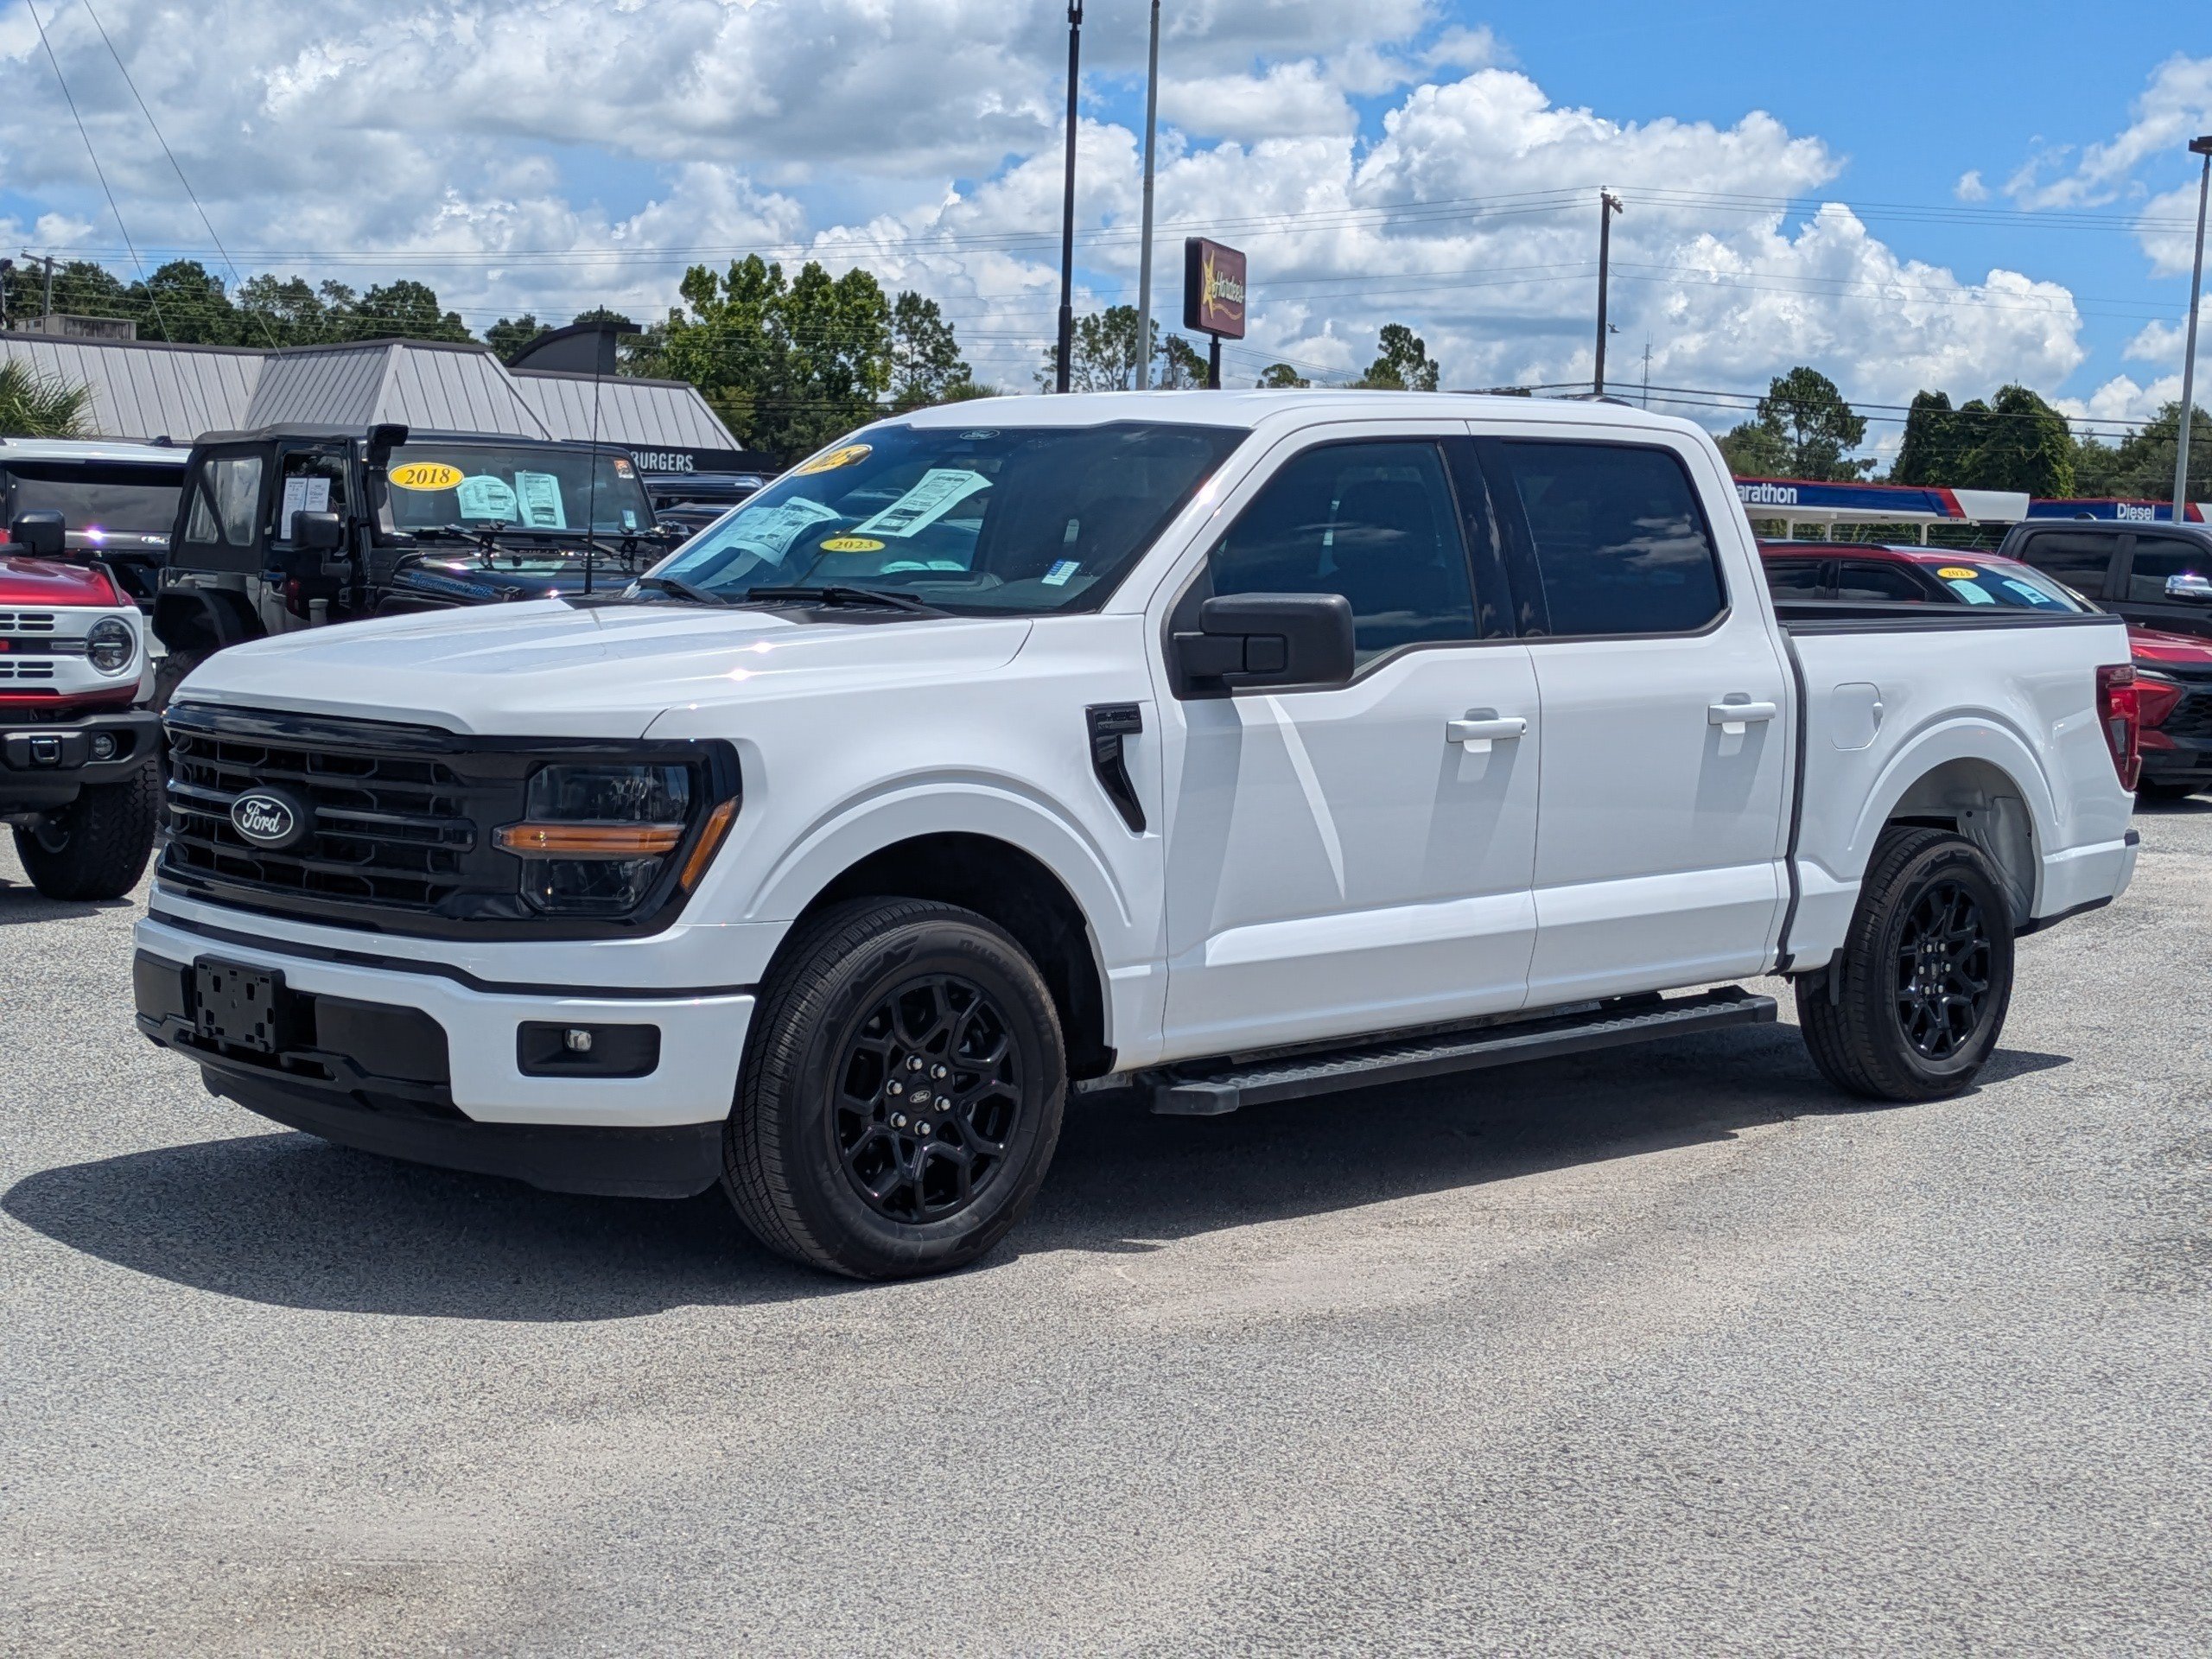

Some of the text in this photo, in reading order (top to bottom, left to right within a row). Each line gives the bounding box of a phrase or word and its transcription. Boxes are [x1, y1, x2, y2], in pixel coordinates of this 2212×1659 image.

[631, 451, 694, 472] BURGERS
[404, 468, 450, 485] 2018
[1737, 482, 1797, 504] arathon
[2117, 502, 2156, 521] Diesel
[834, 540, 874, 550] 2023
[242, 799, 282, 833] Ford
